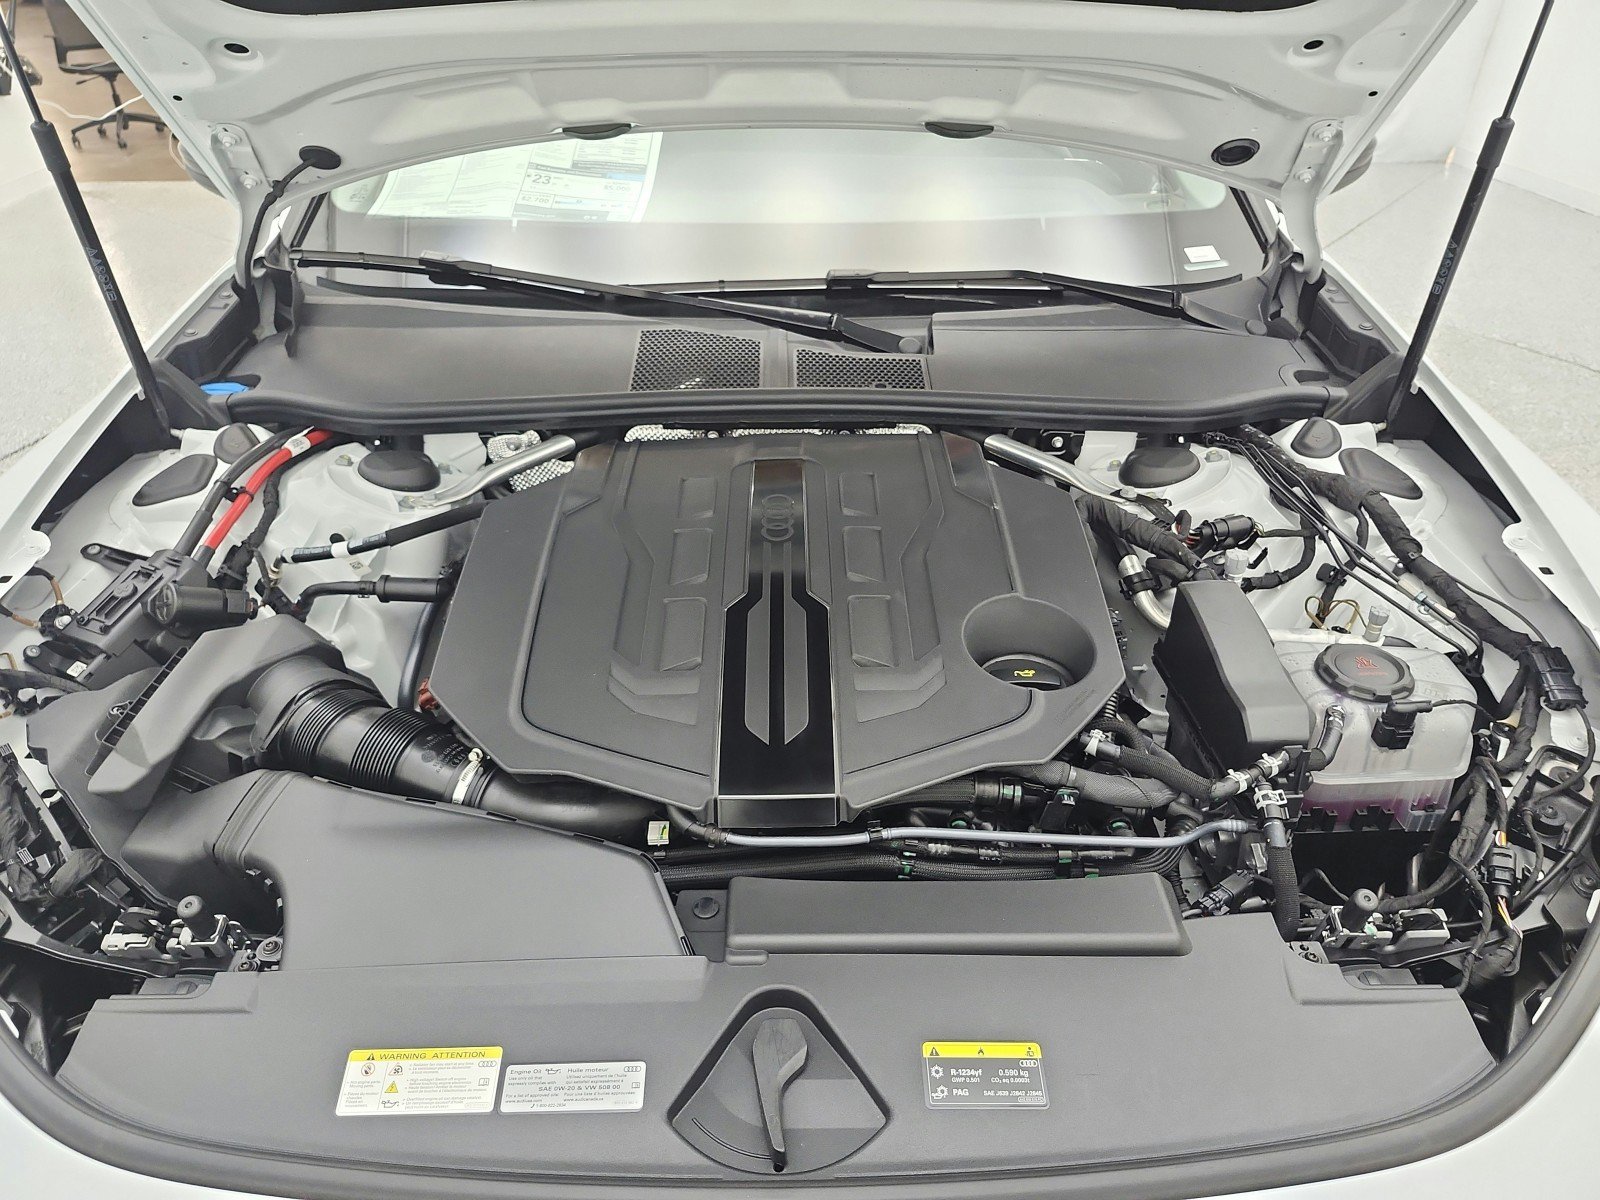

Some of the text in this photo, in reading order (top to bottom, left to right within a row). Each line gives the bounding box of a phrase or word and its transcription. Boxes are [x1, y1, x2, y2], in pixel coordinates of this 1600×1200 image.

[531, 173, 552, 185] 23
[431, 1051, 486, 1059] ATTENTION
[950, 1068, 982, 1077] R-1234yf
[1019, 1068, 1029, 1077] kg
[952, 1088, 969, 1096] PAG
